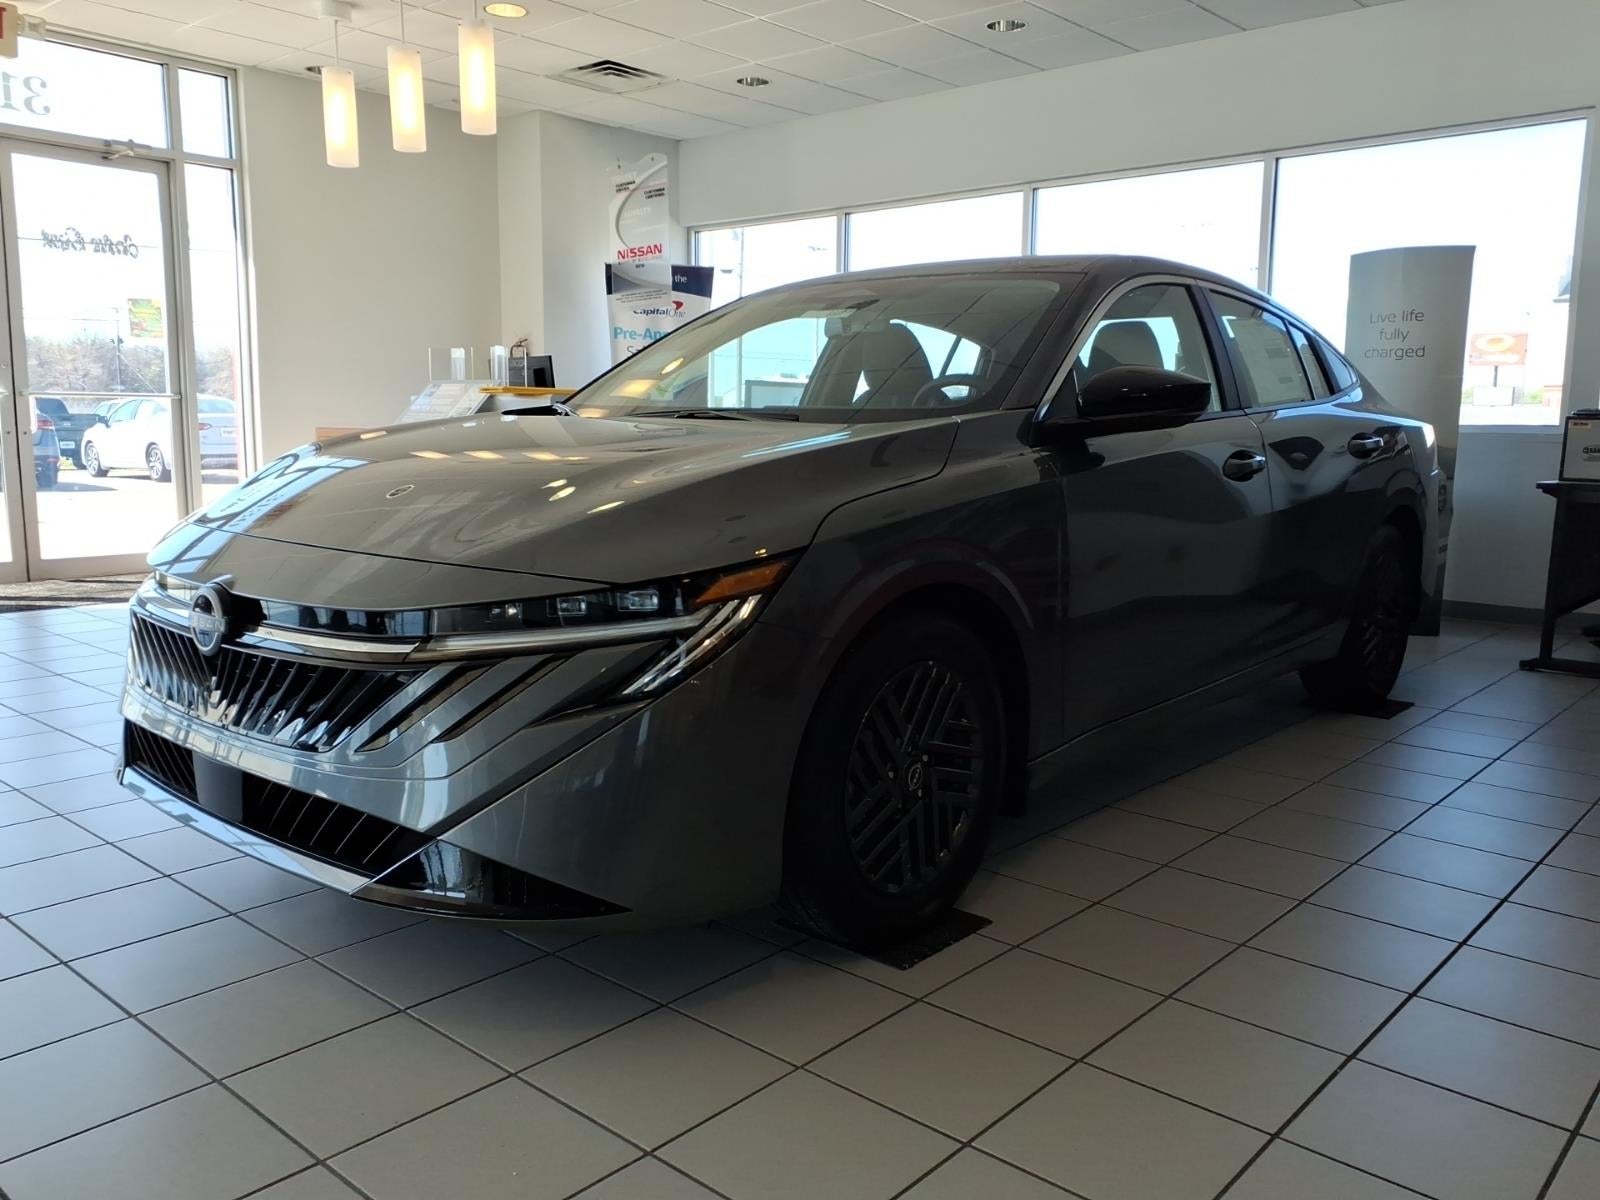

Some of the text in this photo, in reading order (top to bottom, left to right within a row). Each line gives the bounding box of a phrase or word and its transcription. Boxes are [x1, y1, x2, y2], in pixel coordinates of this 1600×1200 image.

[617, 243, 663, 260] NISSAN
[674, 274, 688, 283] the
[1369, 309, 1425, 324] Live life
[1379, 328, 1410, 343] fully
[1364, 345, 1426, 361] charged
